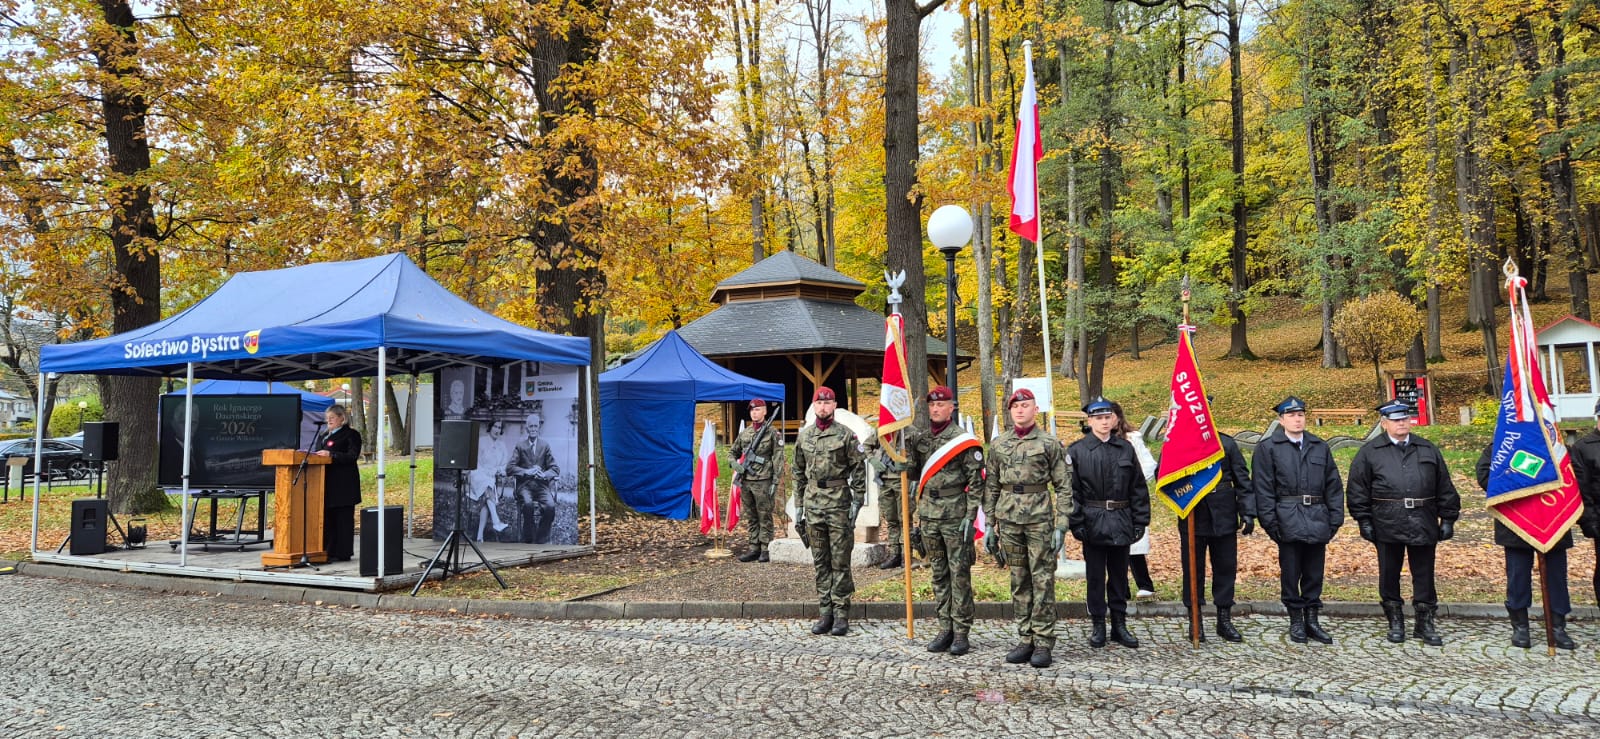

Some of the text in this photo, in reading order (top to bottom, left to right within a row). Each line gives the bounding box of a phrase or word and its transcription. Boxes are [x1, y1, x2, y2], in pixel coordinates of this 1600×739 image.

[124, 335, 240, 359] Sołectwo Bystra
[213, 403, 263, 413] Rok Ignacego
[1176, 371, 1211, 441] SŁUŻBIE
[218, 421, 256, 435] 2026
